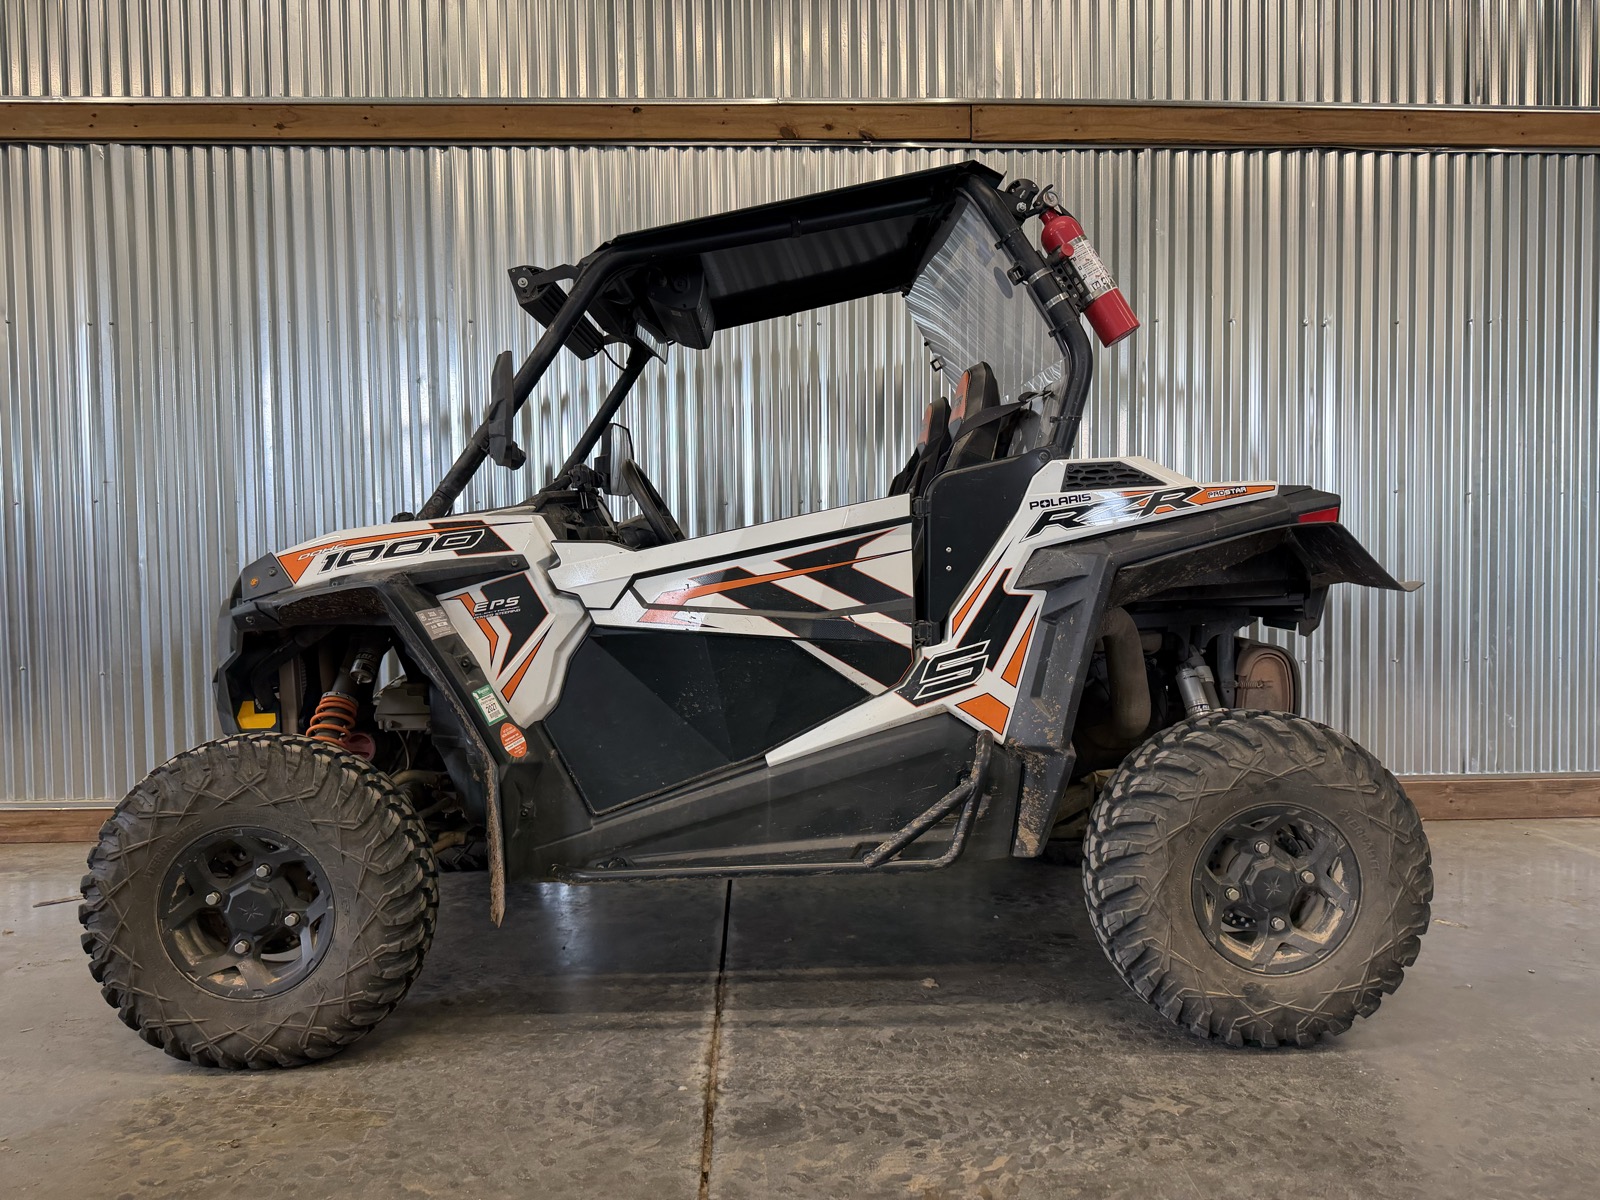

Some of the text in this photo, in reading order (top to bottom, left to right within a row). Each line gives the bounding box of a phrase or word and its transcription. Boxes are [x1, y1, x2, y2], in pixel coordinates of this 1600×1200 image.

[1029, 493, 1092, 510] POLARIS
[1207, 487, 1247, 499] PROSTAR
[317, 528, 485, 575] 1000
[474, 596, 520, 613] EPS
